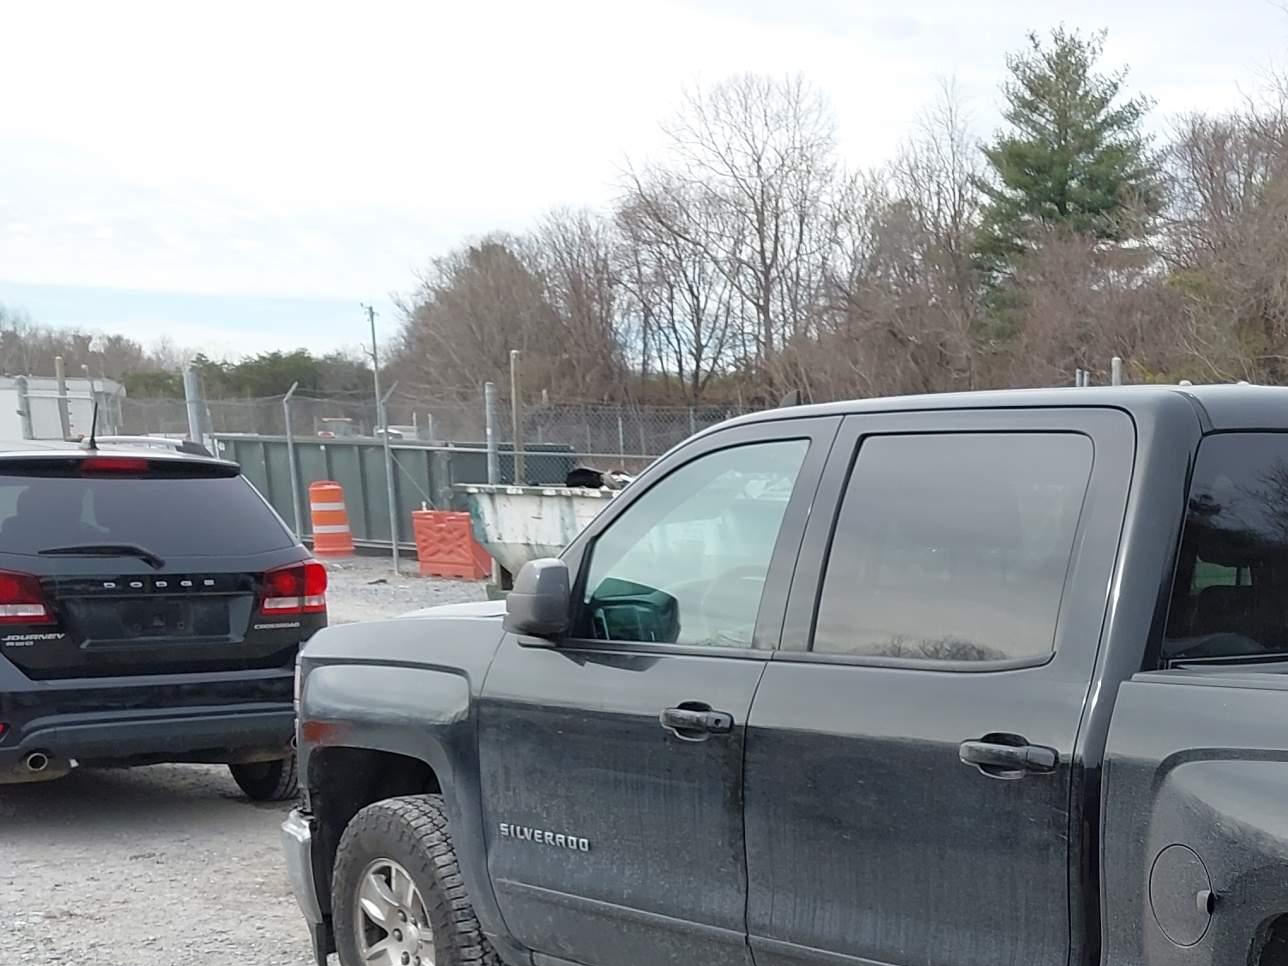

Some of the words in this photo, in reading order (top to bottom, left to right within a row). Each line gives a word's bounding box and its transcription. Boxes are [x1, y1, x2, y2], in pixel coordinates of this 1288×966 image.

[103, 579, 215, 589] DODGE
[1, 633, 66, 641] JOURNEY
[499, 822, 591, 853] SILVERADO
